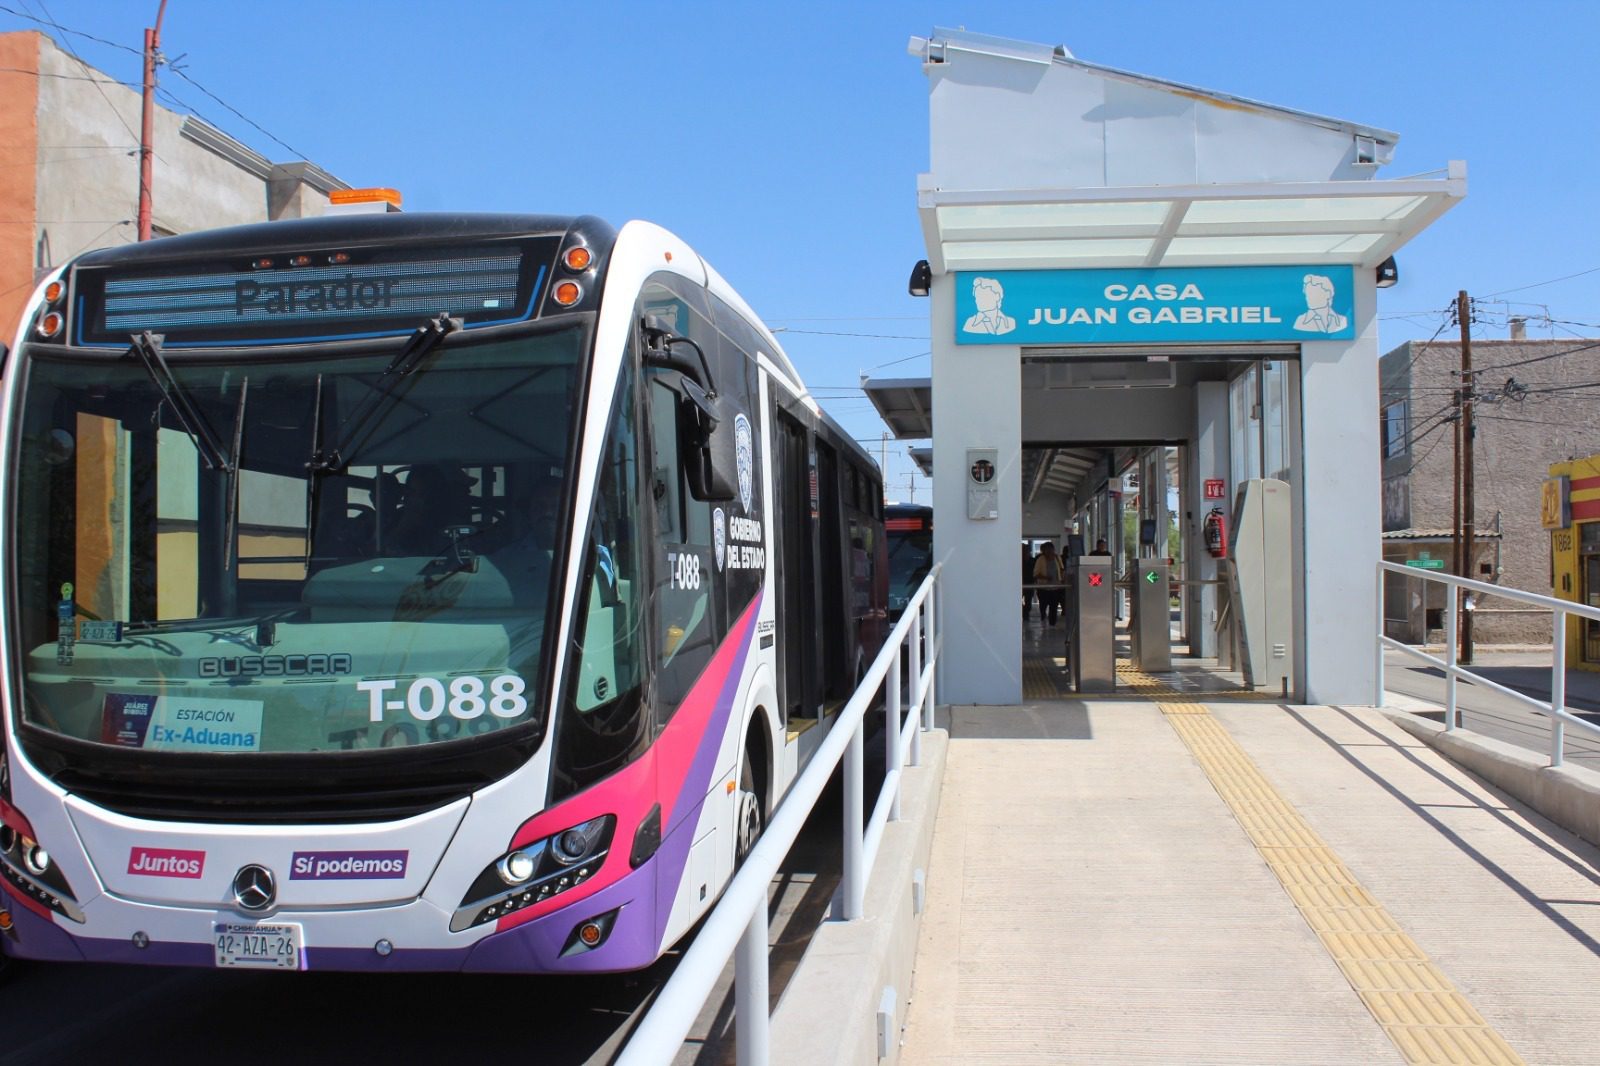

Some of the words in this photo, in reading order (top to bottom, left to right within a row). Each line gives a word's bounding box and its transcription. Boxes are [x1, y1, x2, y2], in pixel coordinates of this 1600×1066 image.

[235, 273, 392, 315] Parador
[1104, 283, 1204, 301] CASA
[1028, 307, 1117, 325] JUAN
[1127, 306, 1282, 324] GABRIEL
[730, 516, 761, 542] GOBIERNO
[727, 545, 741, 569] DEL
[742, 546, 765, 569] ESTADO
[668, 553, 700, 590] T-088
[199, 653, 352, 678] BUSSCAR
[356, 675, 528, 722] T-088
[176, 709, 235, 723] ESTACIÓN
[152, 725, 256, 747] Ex-Aduana
[132, 853, 200, 874] Juntos
[295, 857, 315, 874] Sí
[316, 857, 403, 877] podemos
[217, 935, 294, 956] 42-AZA-26
